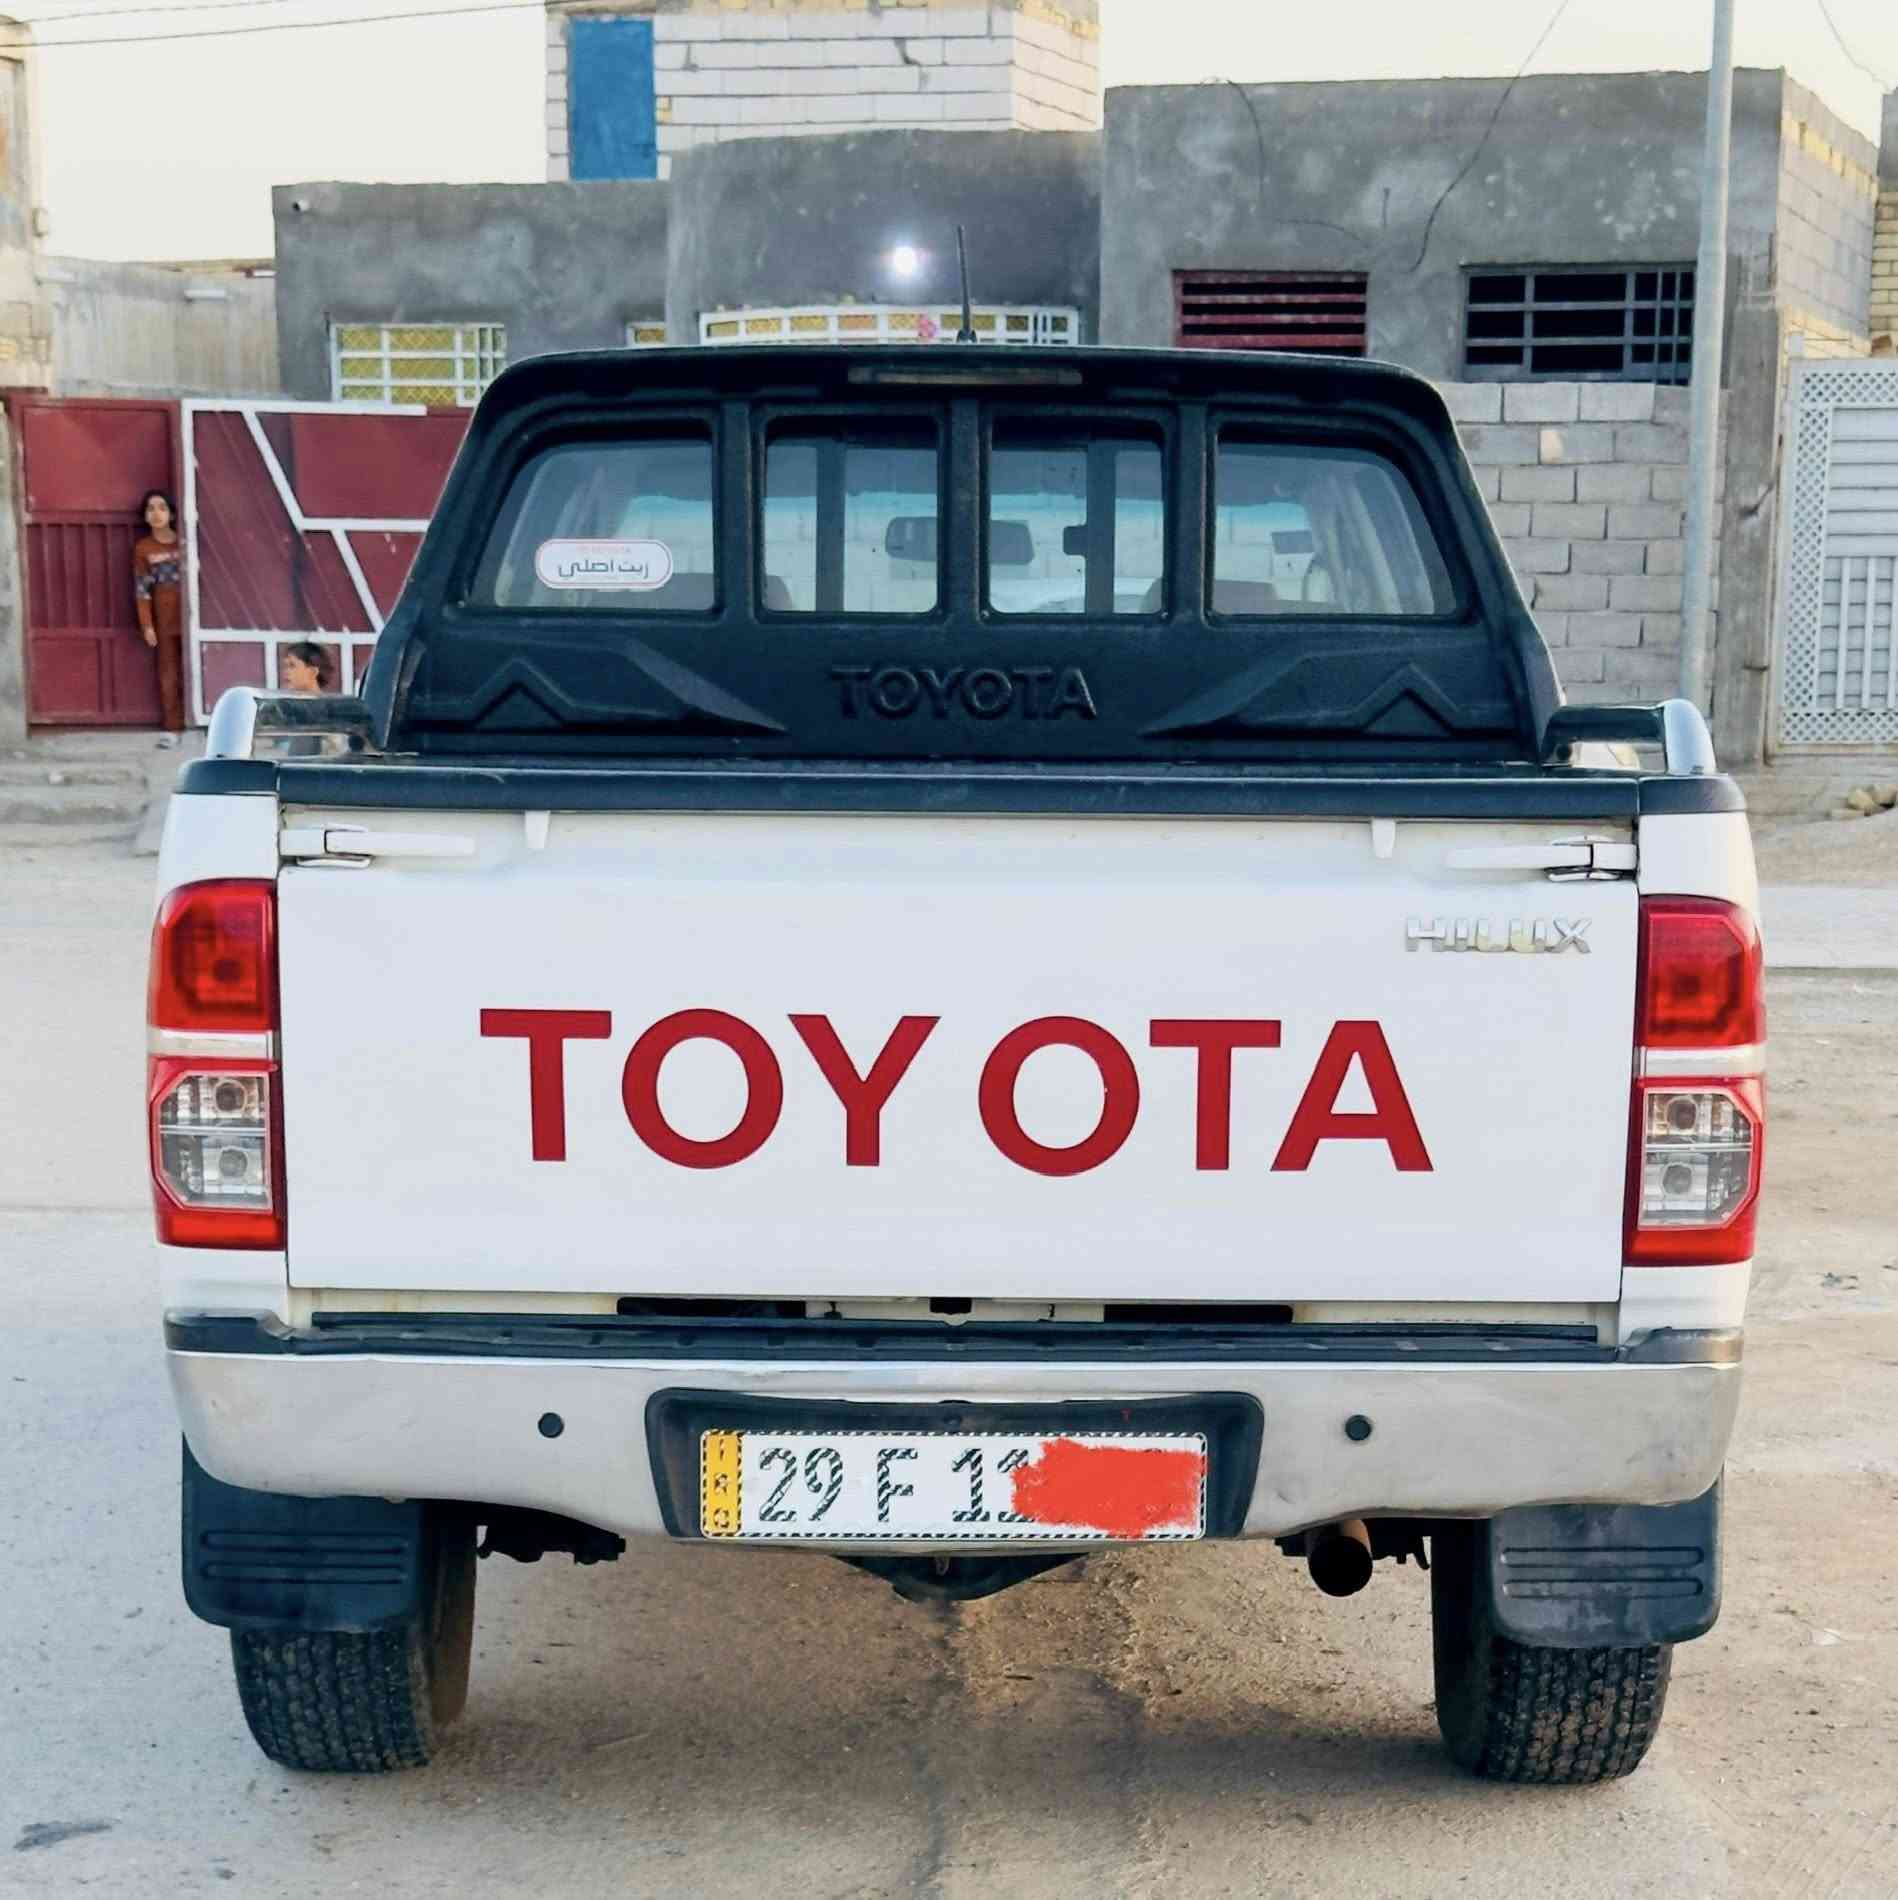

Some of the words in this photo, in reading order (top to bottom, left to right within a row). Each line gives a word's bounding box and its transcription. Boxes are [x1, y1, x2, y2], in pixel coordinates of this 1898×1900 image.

[829, 665, 1098, 721] TOYOTA
[1404, 916, 1593, 954] HILUX
[480, 1008, 1432, 1176] TOYOTA
[759, 1447, 843, 1521] 29
[876, 1448, 918, 1521] F
